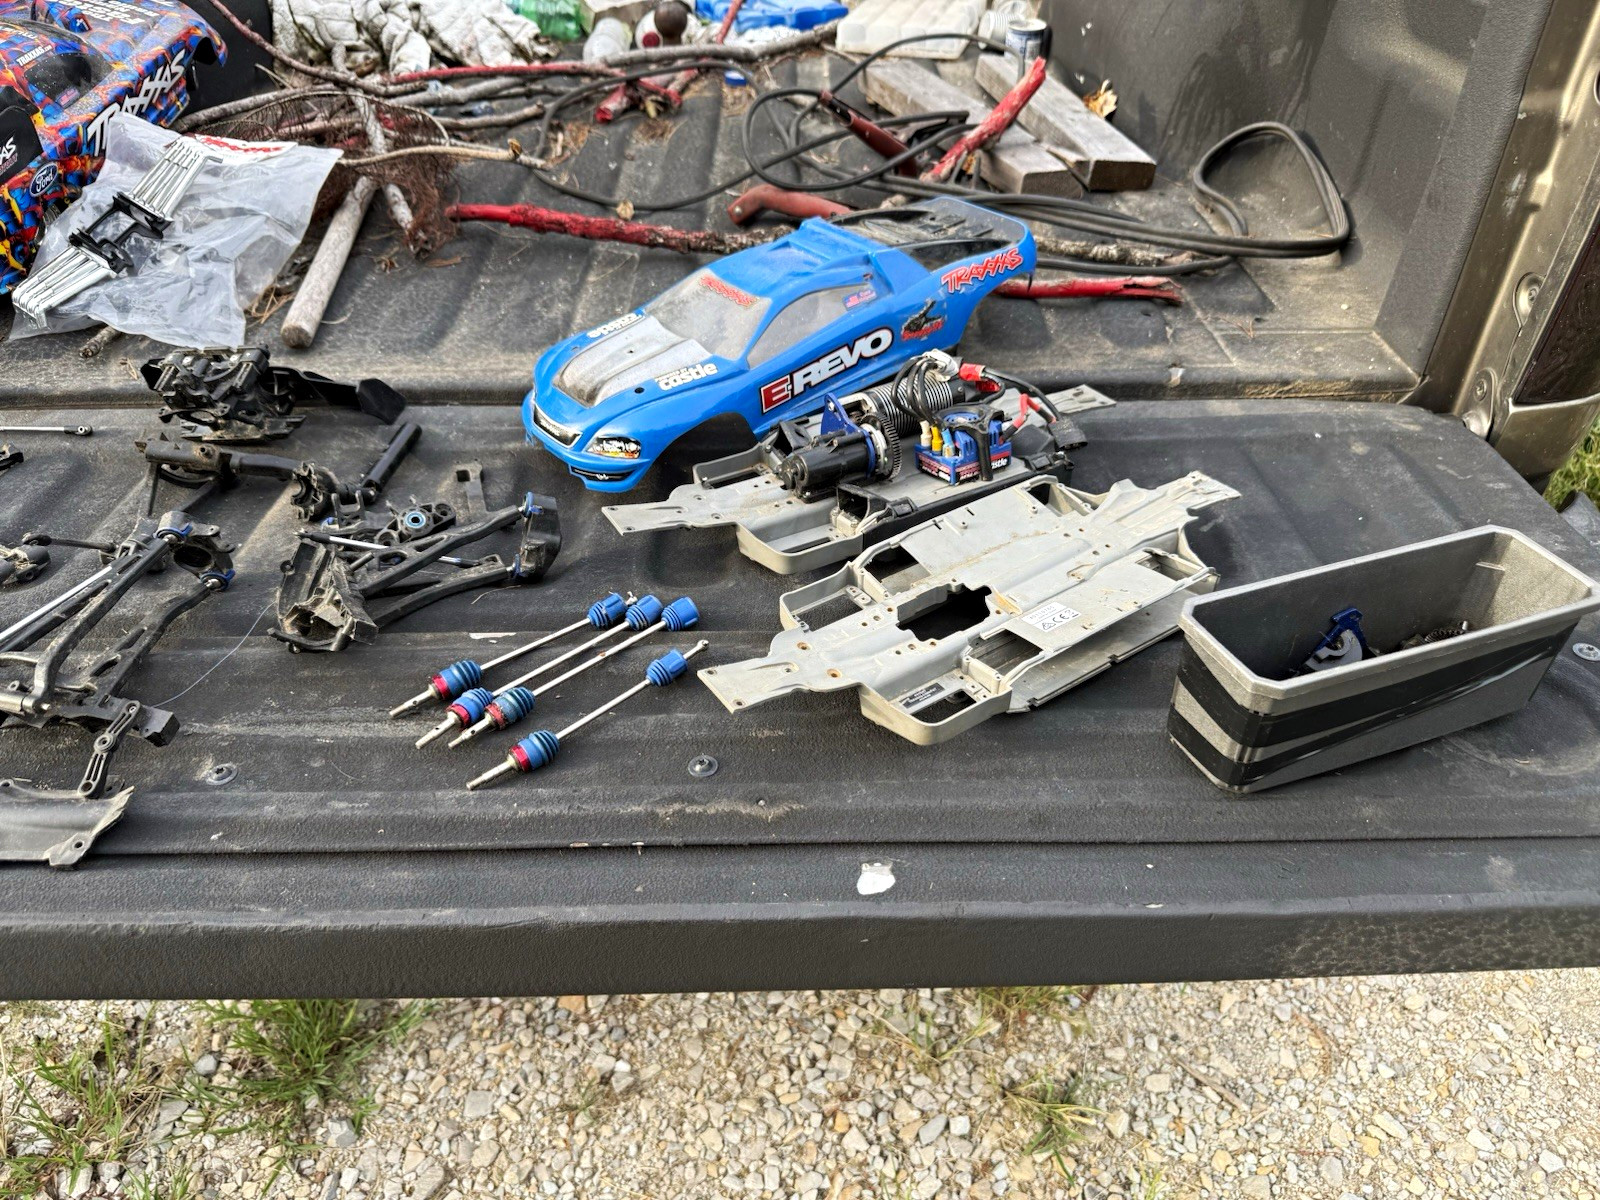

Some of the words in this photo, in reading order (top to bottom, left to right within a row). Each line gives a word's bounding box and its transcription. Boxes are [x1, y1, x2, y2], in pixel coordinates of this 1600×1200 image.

[36, 168, 54, 193] Ford
[941, 247, 1023, 293] TRAXXAS
[659, 363, 719, 391] castle
